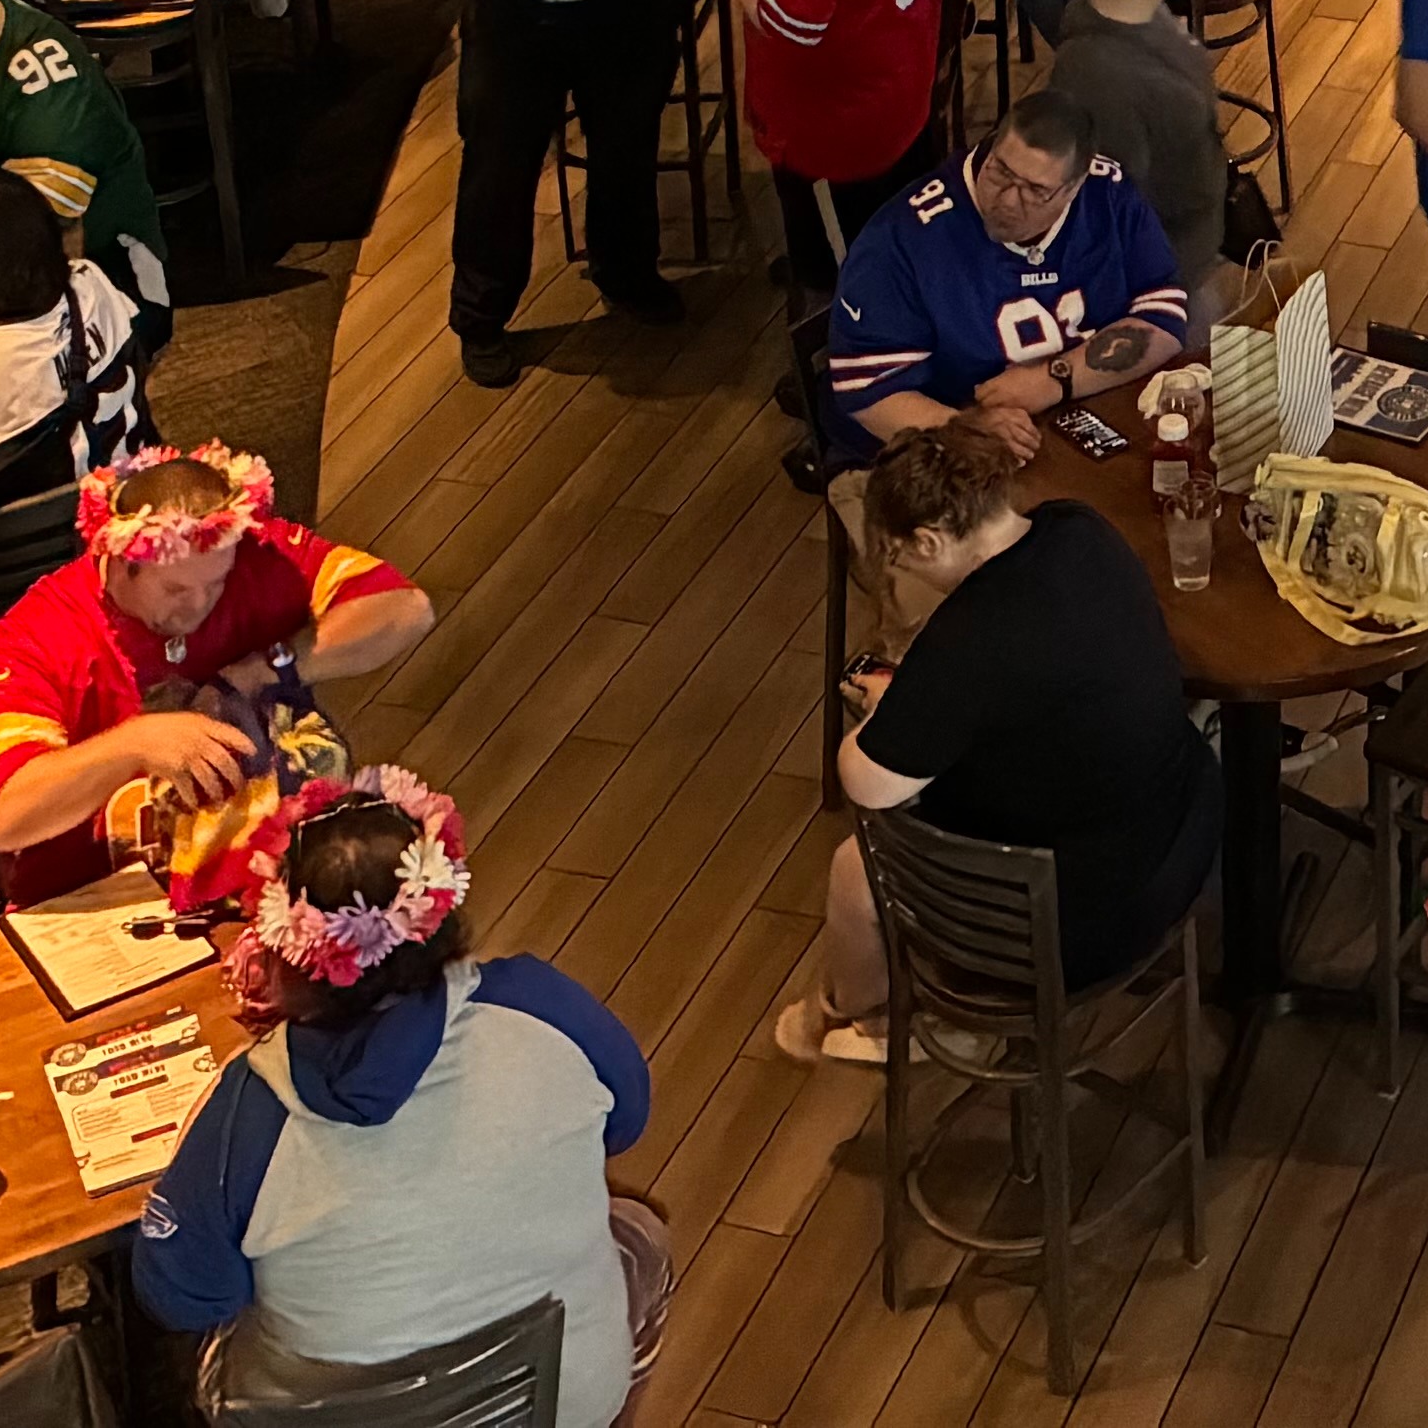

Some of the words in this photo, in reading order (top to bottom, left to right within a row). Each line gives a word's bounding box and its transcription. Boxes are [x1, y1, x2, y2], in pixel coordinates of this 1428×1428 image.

[7, 37, 78, 96] 92
[907, 178, 954, 225] 91
[1020, 271, 1060, 287] BILLS
